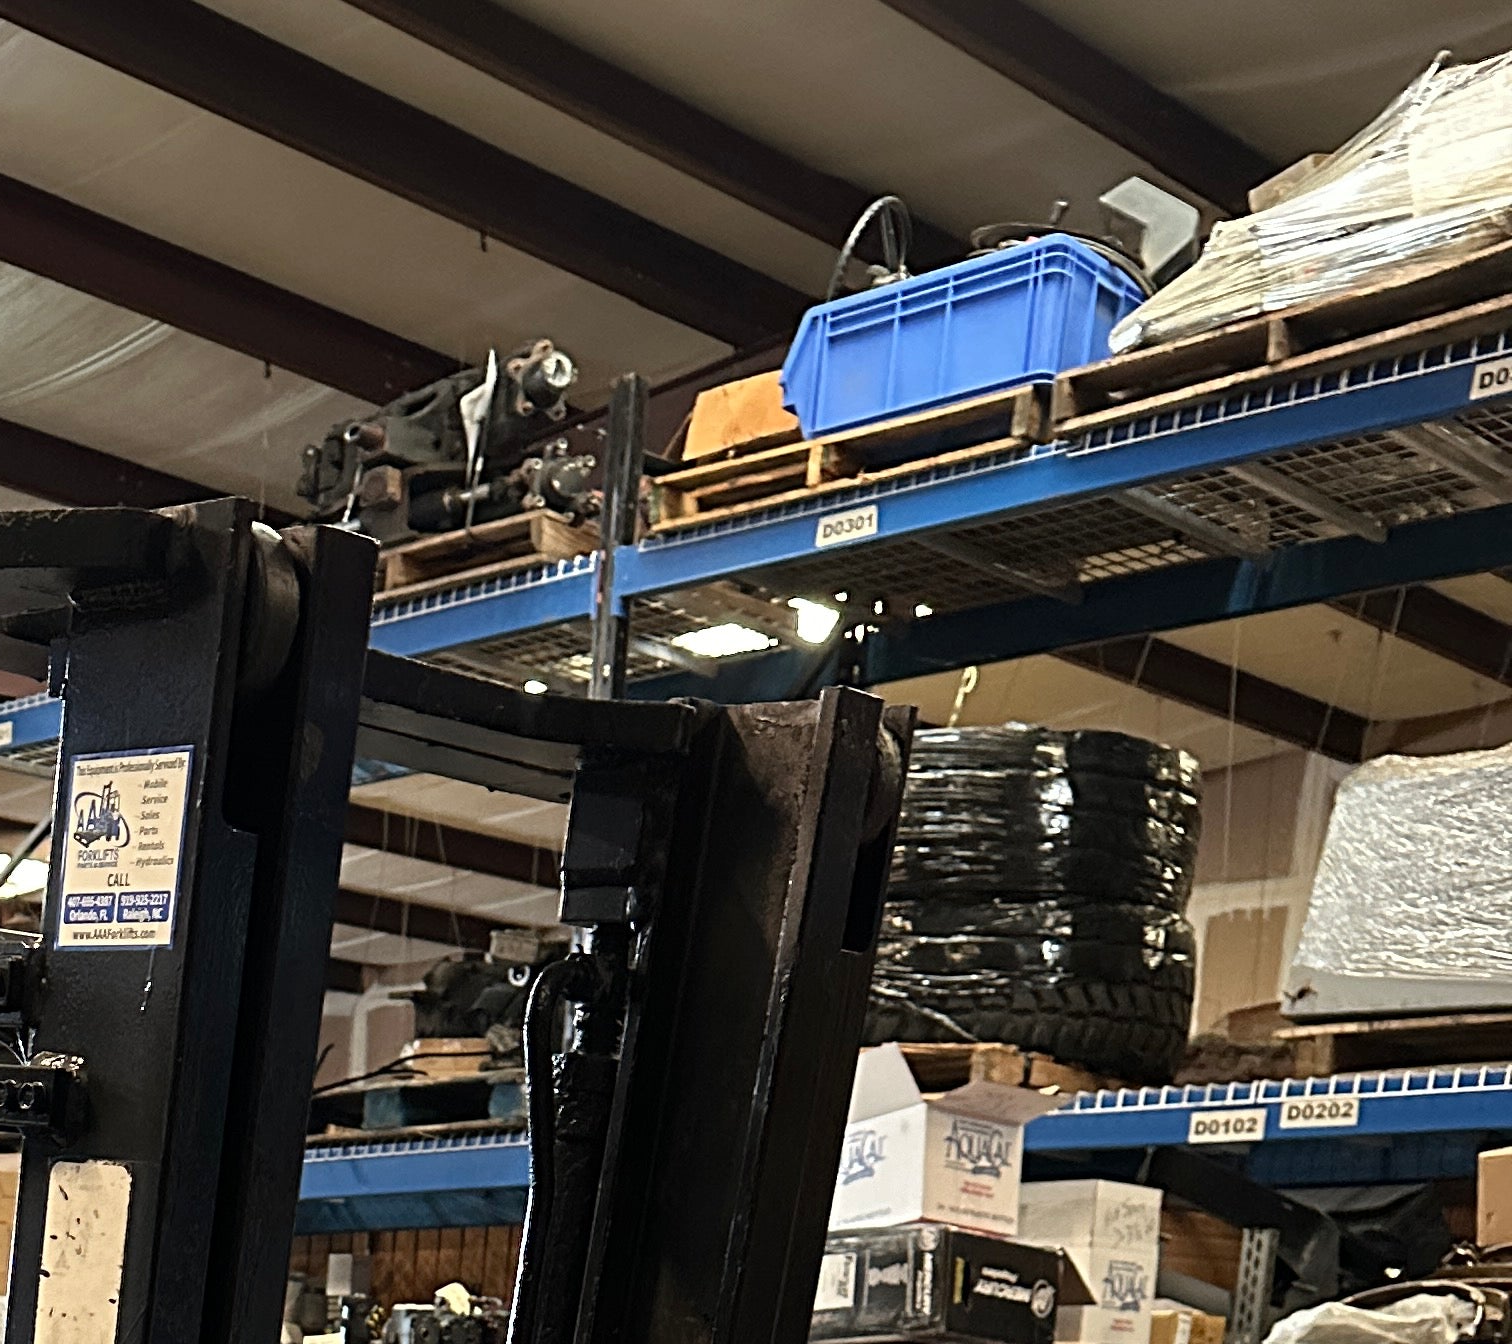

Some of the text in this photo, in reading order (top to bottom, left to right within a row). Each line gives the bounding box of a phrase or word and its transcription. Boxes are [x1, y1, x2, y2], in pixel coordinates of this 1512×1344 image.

[1479, 366, 1512, 390] D0
[822, 513, 874, 539] D0301
[144, 778, 168, 789] Mobile
[141, 794, 168, 805] Service
[140, 810, 160, 820] Sales
[139, 826, 158, 836] Parts
[138, 841, 165, 851] Rentals
[78, 848, 119, 861] FORKLIFTS
[135, 855, 174, 868] Hydraulics
[107, 873, 130, 887] CALL
[99, 909, 108, 920] FL
[73, 927, 156, 940] www.AAAForklifts.com
[1288, 1102, 1354, 1121] D0202
[1194, 1117, 1258, 1136] D0102
